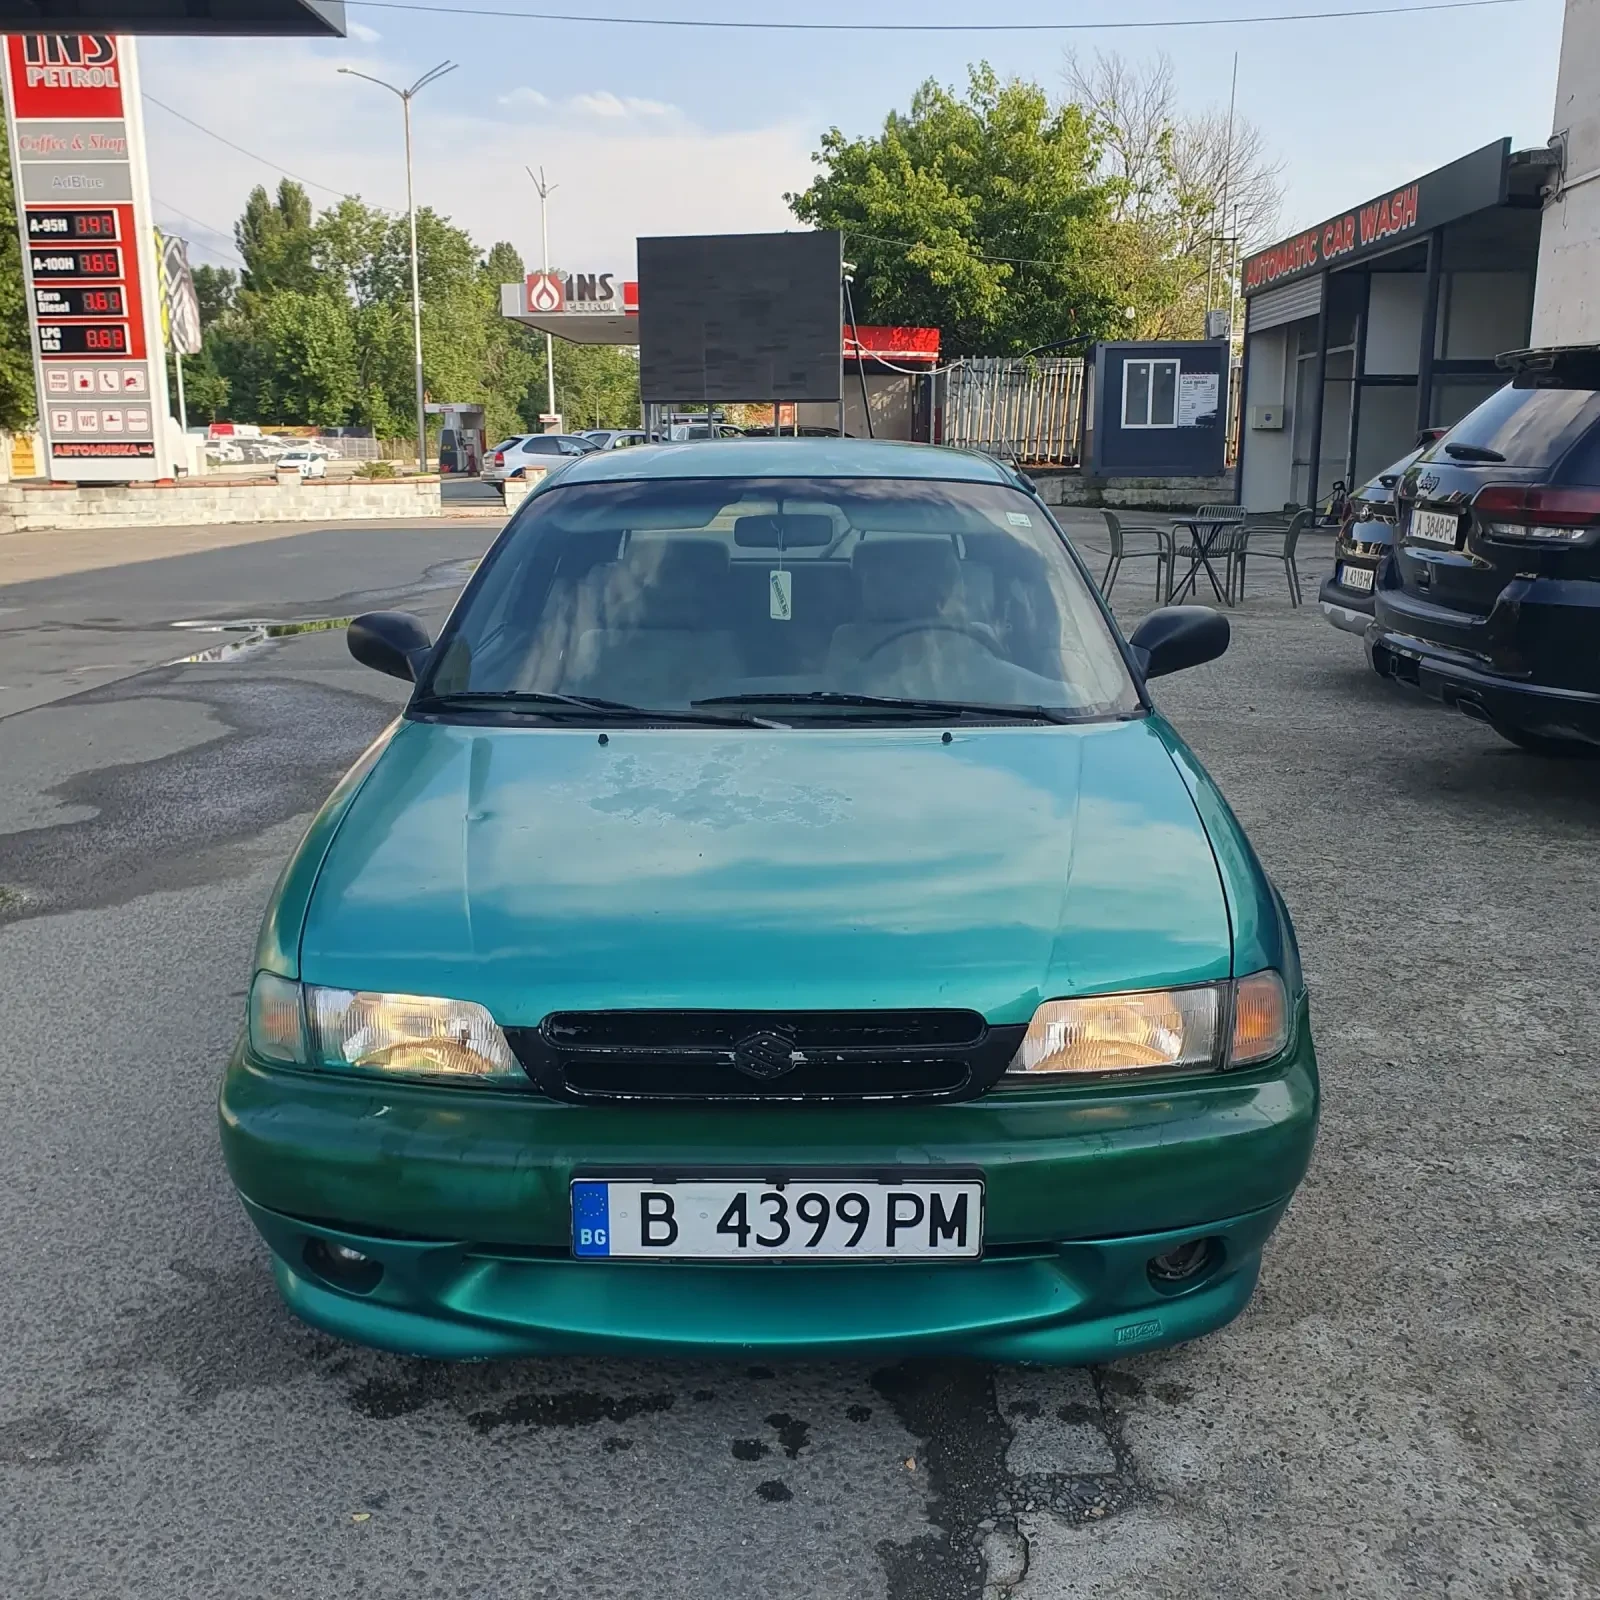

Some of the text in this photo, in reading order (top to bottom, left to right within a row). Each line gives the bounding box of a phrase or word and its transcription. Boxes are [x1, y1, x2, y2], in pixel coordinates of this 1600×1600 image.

[25, 35, 116, 65] INS
[26, 66, 118, 88] PETROL
[20, 133, 125, 155] Coffee & Shop
[52, 176, 103, 189] AdBlue
[30, 219, 68, 233] A-95H
[1245, 184, 1418, 290] AUTOMATIC CAR WASH
[33, 257, 74, 271] A-100H
[565, 273, 614, 301] INS
[36, 290, 61, 301] Euro
[38, 302, 70, 313] Diesel
[566, 301, 617, 312] PETROL
[40, 328, 62, 339] LPG
[80, 415, 96, 427] WC
[54, 444, 141, 456] АВТОМИВКА
[1417, 514, 1422, 534] A
[640, 1191, 969, 1248] B 4399 PM
[580, 1228, 607, 1245] BG
